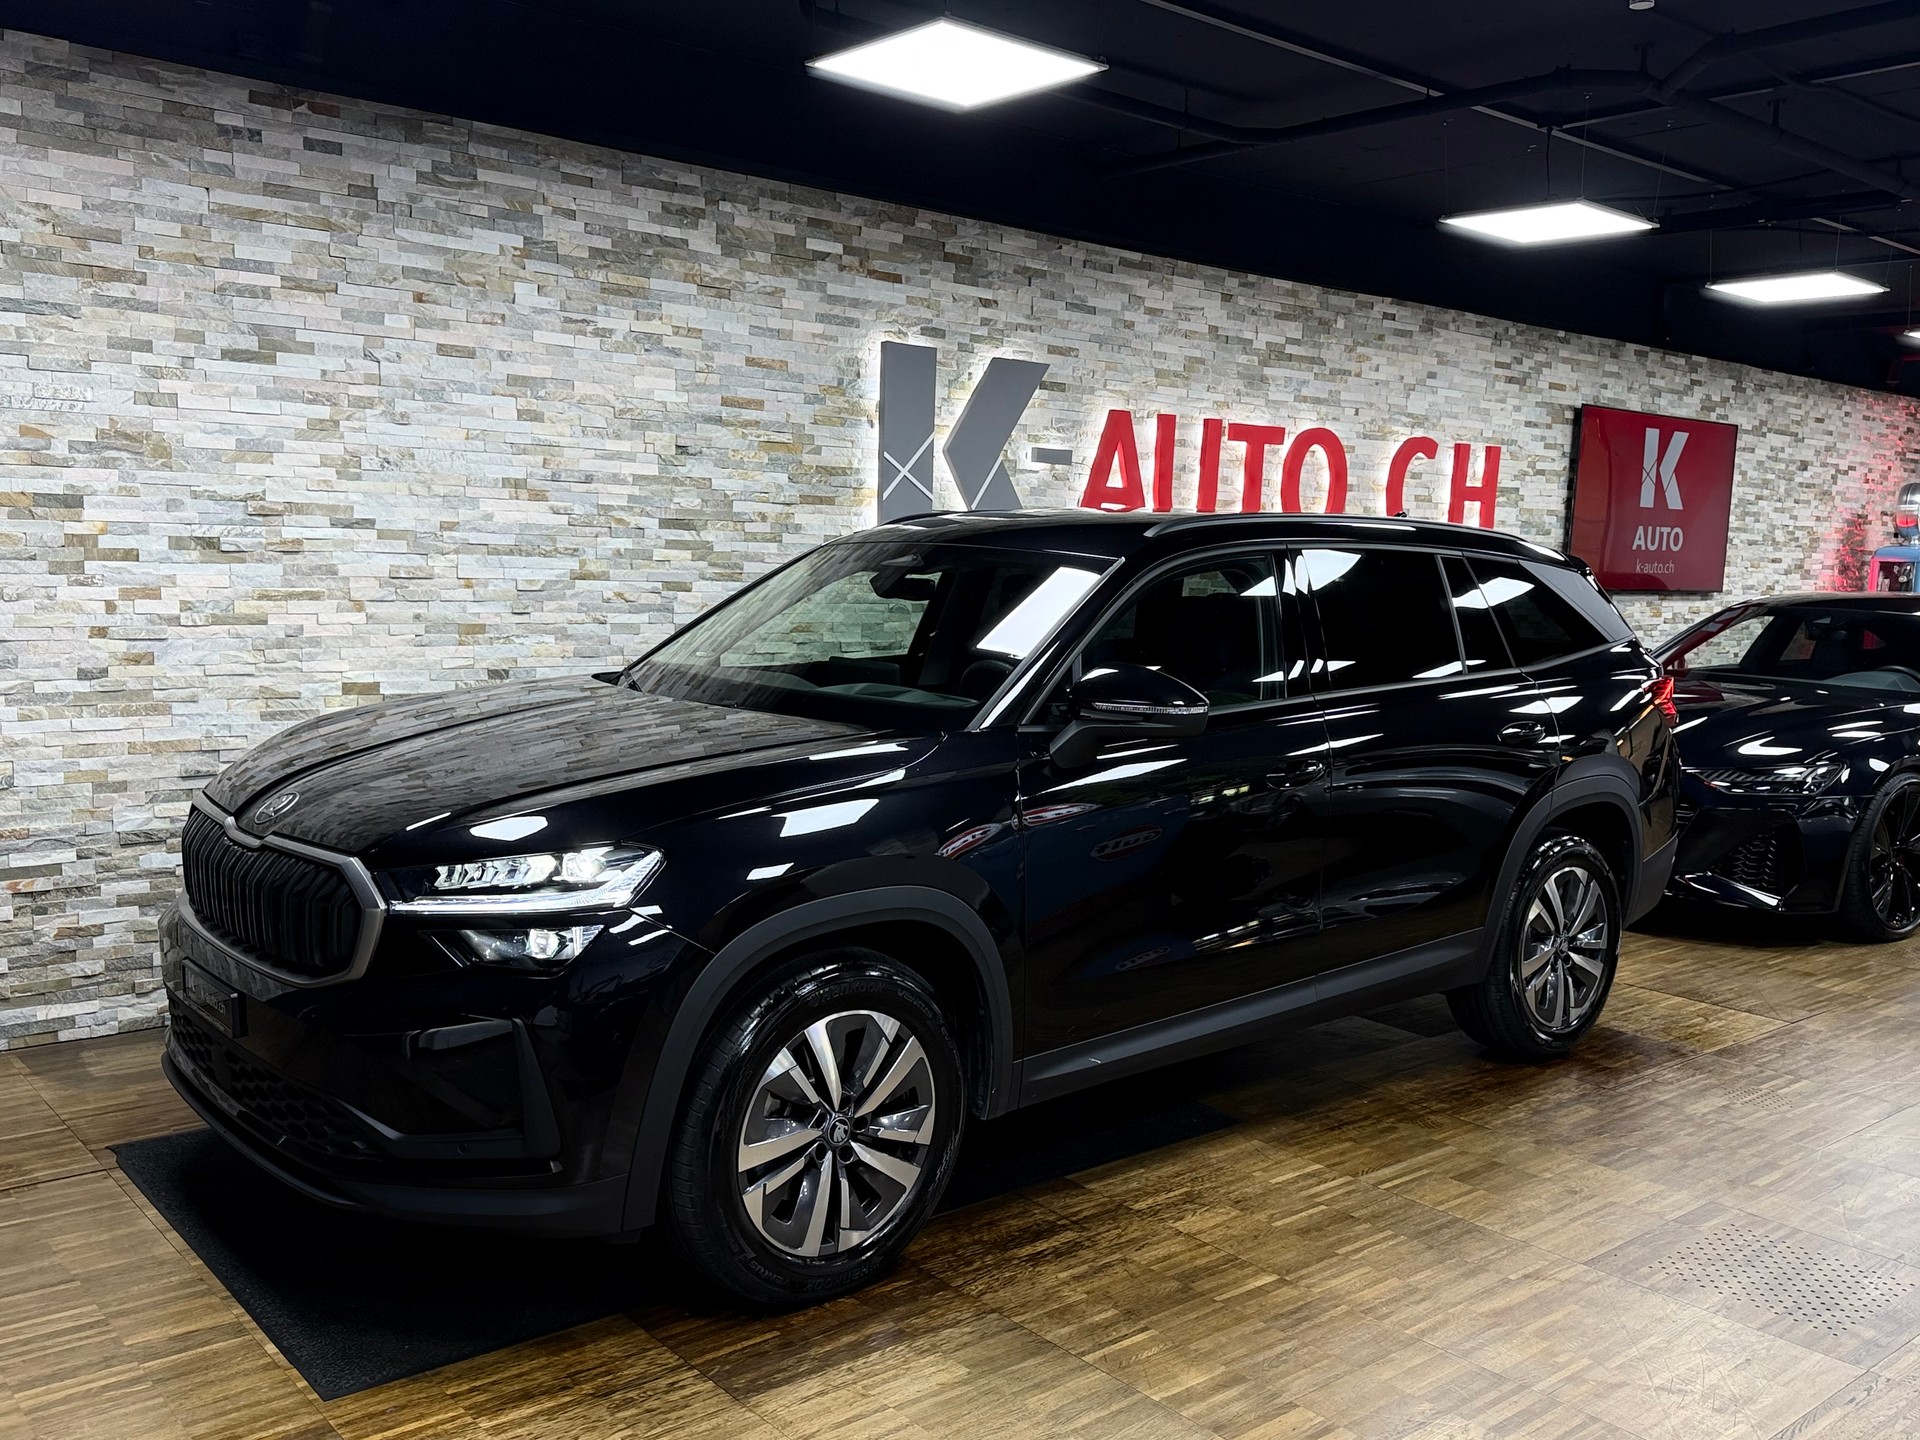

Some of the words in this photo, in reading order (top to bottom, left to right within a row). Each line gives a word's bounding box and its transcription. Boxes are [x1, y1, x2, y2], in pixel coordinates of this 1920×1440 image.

[1640, 427, 1690, 511] K
[1632, 525, 1684, 552] AUTO
[1635, 558, 1675, 574] k-auto.ch
